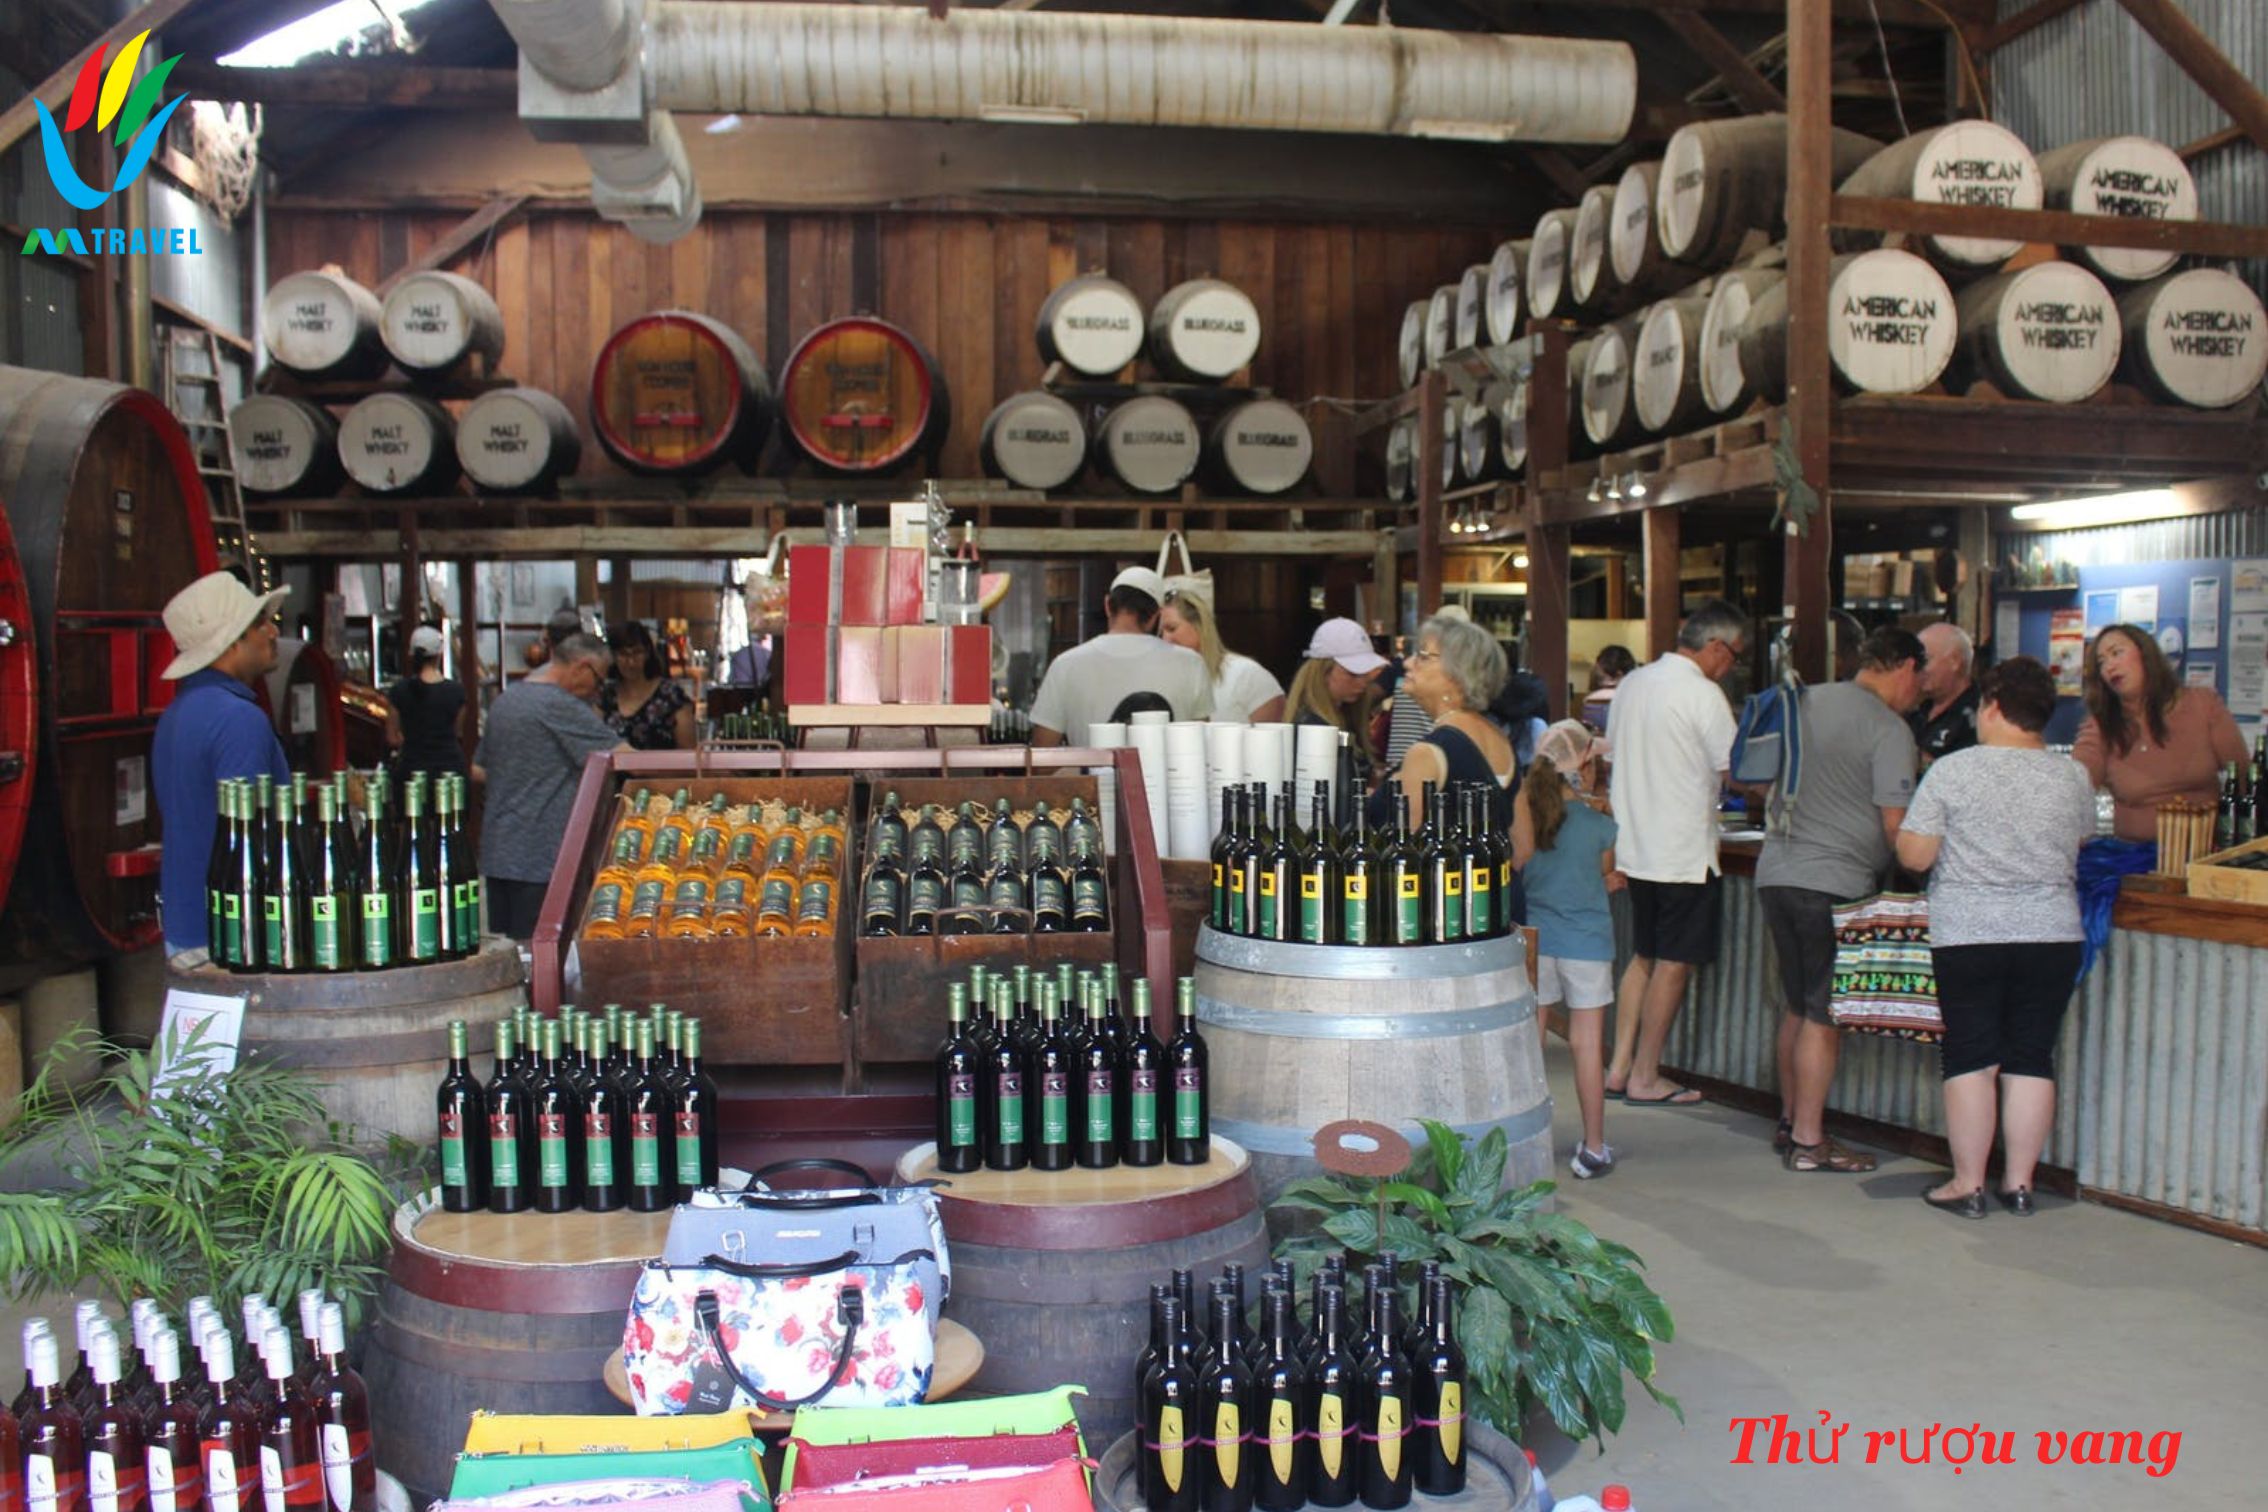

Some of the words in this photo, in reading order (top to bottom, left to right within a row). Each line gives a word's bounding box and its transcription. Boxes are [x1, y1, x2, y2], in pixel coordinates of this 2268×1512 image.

[1931, 160, 2023, 180] AMERICAN
[2091, 168, 2179, 197] AMERICAN
[1938, 184, 2017, 208] WHISKEY
[2095, 192, 2169, 220] WHISKEY
[296, 303, 327, 317] MALT
[411, 304, 442, 318] MALT
[1843, 297, 1936, 319] AMERICAN
[2014, 302, 2104, 324] AMERICAN
[2163, 311, 2253, 333] AMERICAN
[1850, 321, 1930, 346] WHISKEY
[2020, 327, 2098, 351] WHISKEY
[2169, 335, 2246, 357] WHISKEY
[253, 430, 284, 444] MALT
[371, 425, 403, 440] MALT
[490, 424, 521, 438] MALT
